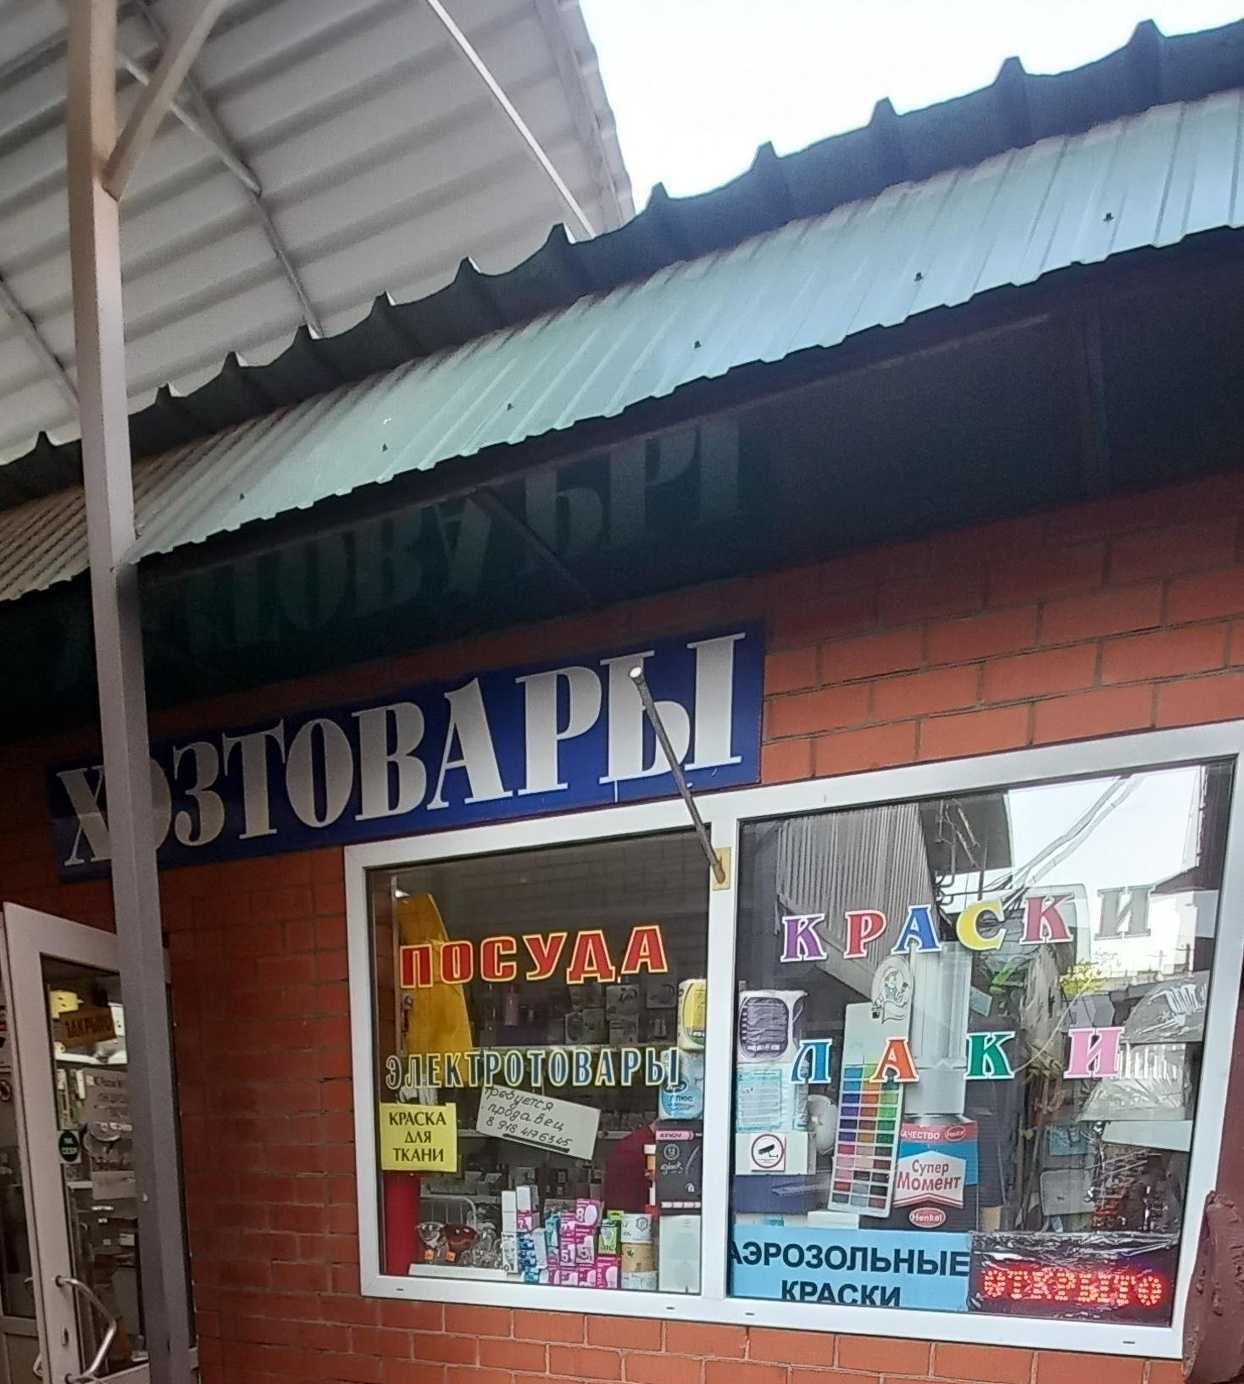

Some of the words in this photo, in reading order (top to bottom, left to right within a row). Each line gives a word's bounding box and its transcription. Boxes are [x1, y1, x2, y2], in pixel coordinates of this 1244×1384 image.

[780, 886, 1153, 963] КРАСКИ
[400, 924, 669, 988] ПОСУДА
[791, 1025, 1126, 1084] ЛАКИ
[385, 1047, 681, 1089] ЭЛЕКТРОТОВАРЫ
[388, 1111, 447, 1126] КРАСКА
[486, 1116, 495, 1127] 8
[487, 1103, 564, 1131] продавец
[404, 1130, 432, 1144] ДЛЯ
[900, 1129, 941, 1140] АЧЕСТВО
[392, 1147, 444, 1163] ТКАНИ
[912, 1159, 949, 1176] Супер
[896, 1171, 962, 1191] Момент
[911, 1212, 943, 1222] Henkel
[728, 1240, 970, 1277] АЭРОЗОЛЬНЫЕ
[780, 1279, 901, 1307] КРАСКИ
[984, 1267, 1162, 1306] ОТКРЫТО
